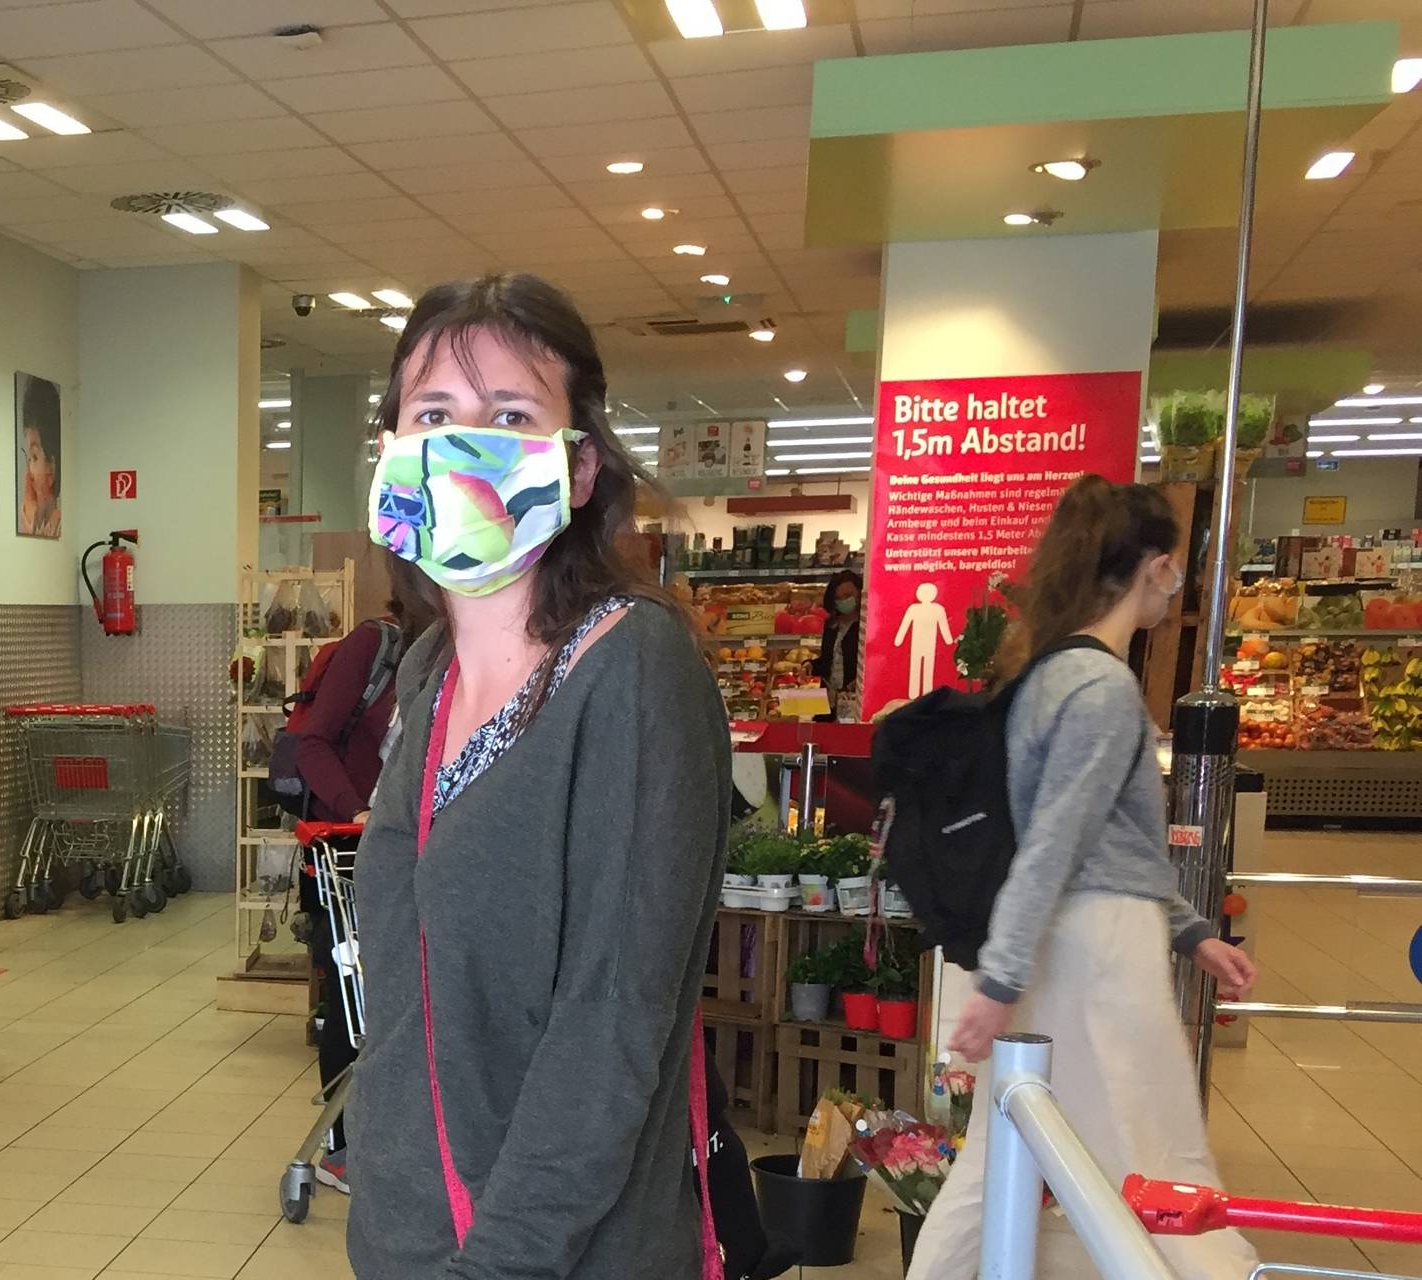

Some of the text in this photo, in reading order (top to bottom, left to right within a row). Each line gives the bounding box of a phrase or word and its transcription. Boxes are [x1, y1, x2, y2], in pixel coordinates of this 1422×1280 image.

[894, 392, 1048, 424] Bitte haltet
[891, 423, 1087, 460] 1,5m Abstand!
[889, 475, 919, 485] Deine
[920, 473, 978, 485] Gesundheit
[980, 472, 1004, 484] liegt
[1006, 473, 1025, 481] uns
[1027, 473, 1042, 481] am
[889, 487, 1067, 502] Wichtige Maßnahmen sind regelmä
[888, 501, 1053, 515] Händewaschen, Husten & Niesen
[887, 518, 938, 530] Armbeuge
[940, 517, 960, 528] und
[962, 516, 988, 527] beim
[990, 514, 1030, 526] Einkauf
[886, 532, 915, 543] Kasse
[917, 531, 976, 541] mindestens
[995, 529, 1026, 539] Meter
[885, 545, 1035, 558] Unterstützt unsere Mitarbeite
[884, 559, 1017, 572] wenn möglich, bargeldlos!
